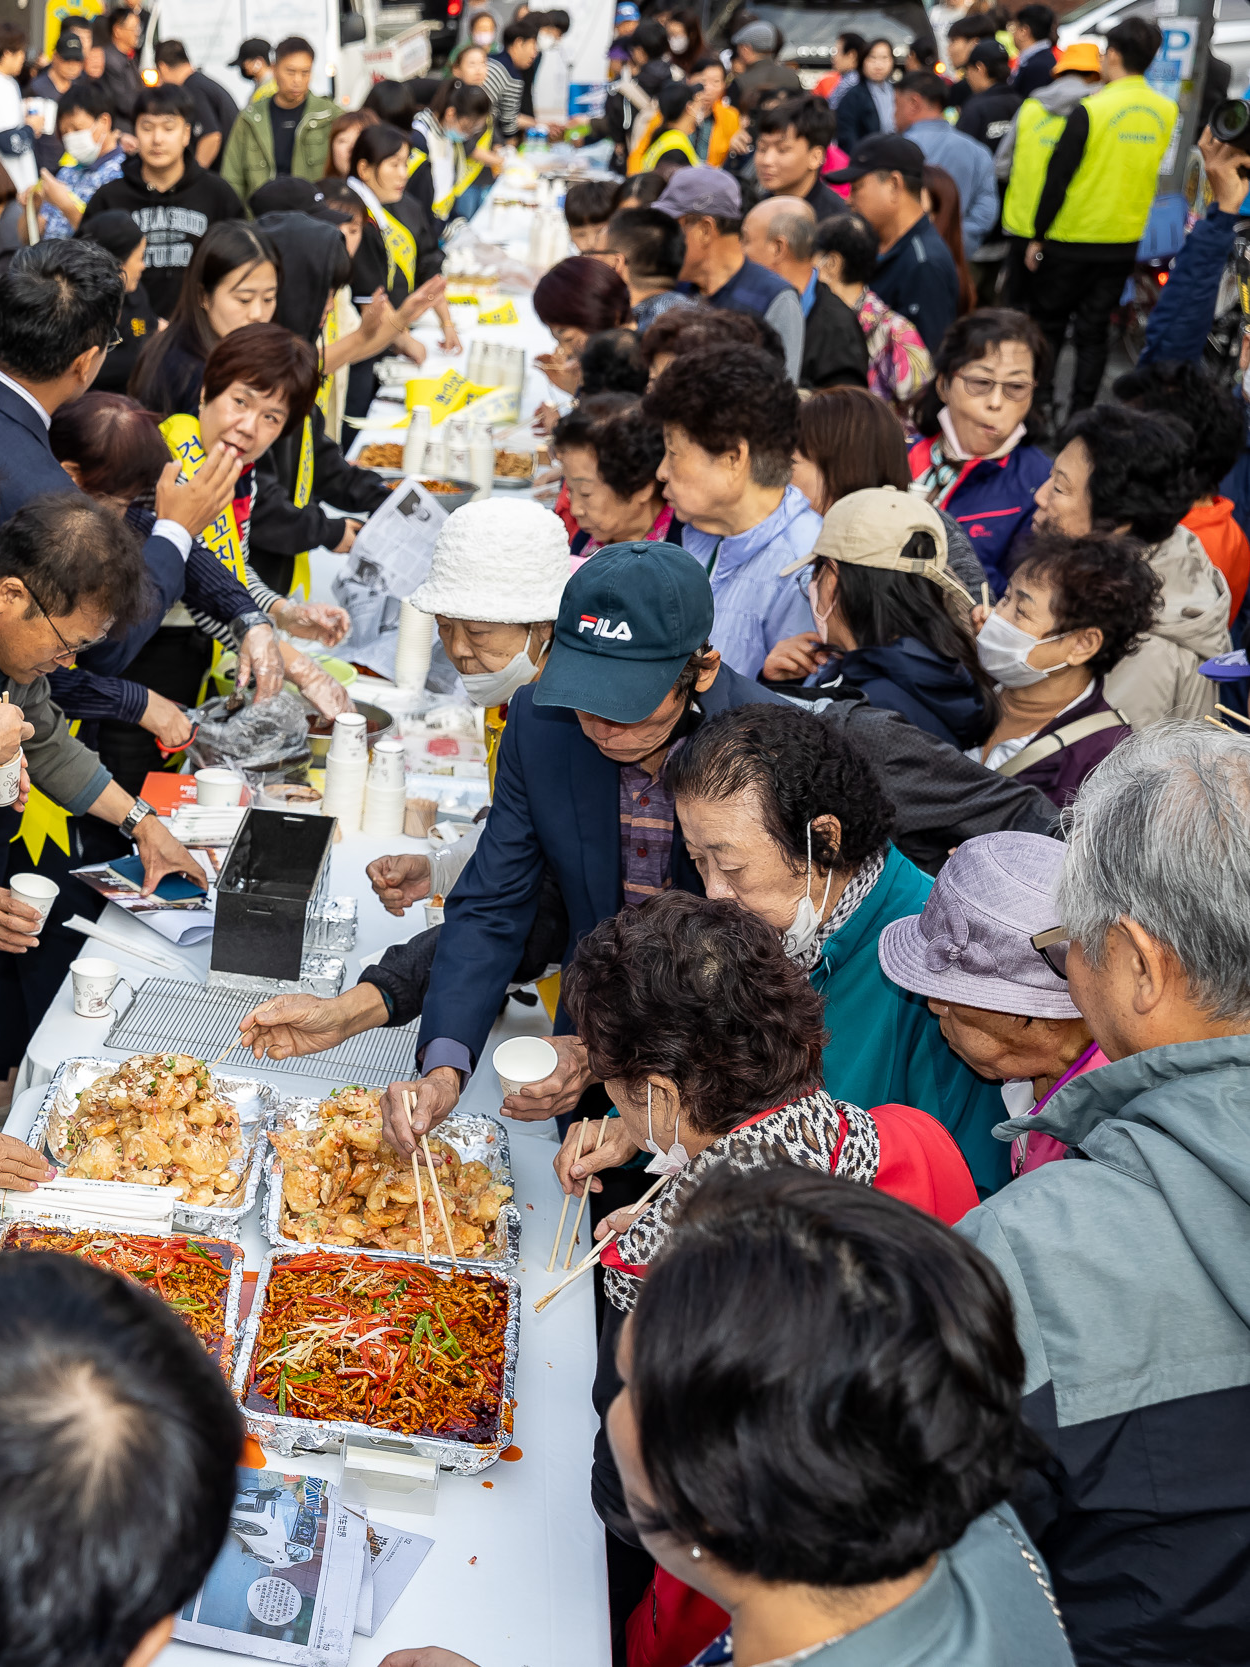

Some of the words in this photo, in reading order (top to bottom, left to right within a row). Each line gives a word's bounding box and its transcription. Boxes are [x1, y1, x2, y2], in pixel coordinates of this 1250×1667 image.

[578, 614, 632, 642] FILA
[337, 1513, 348, 1538] 汽车世界
